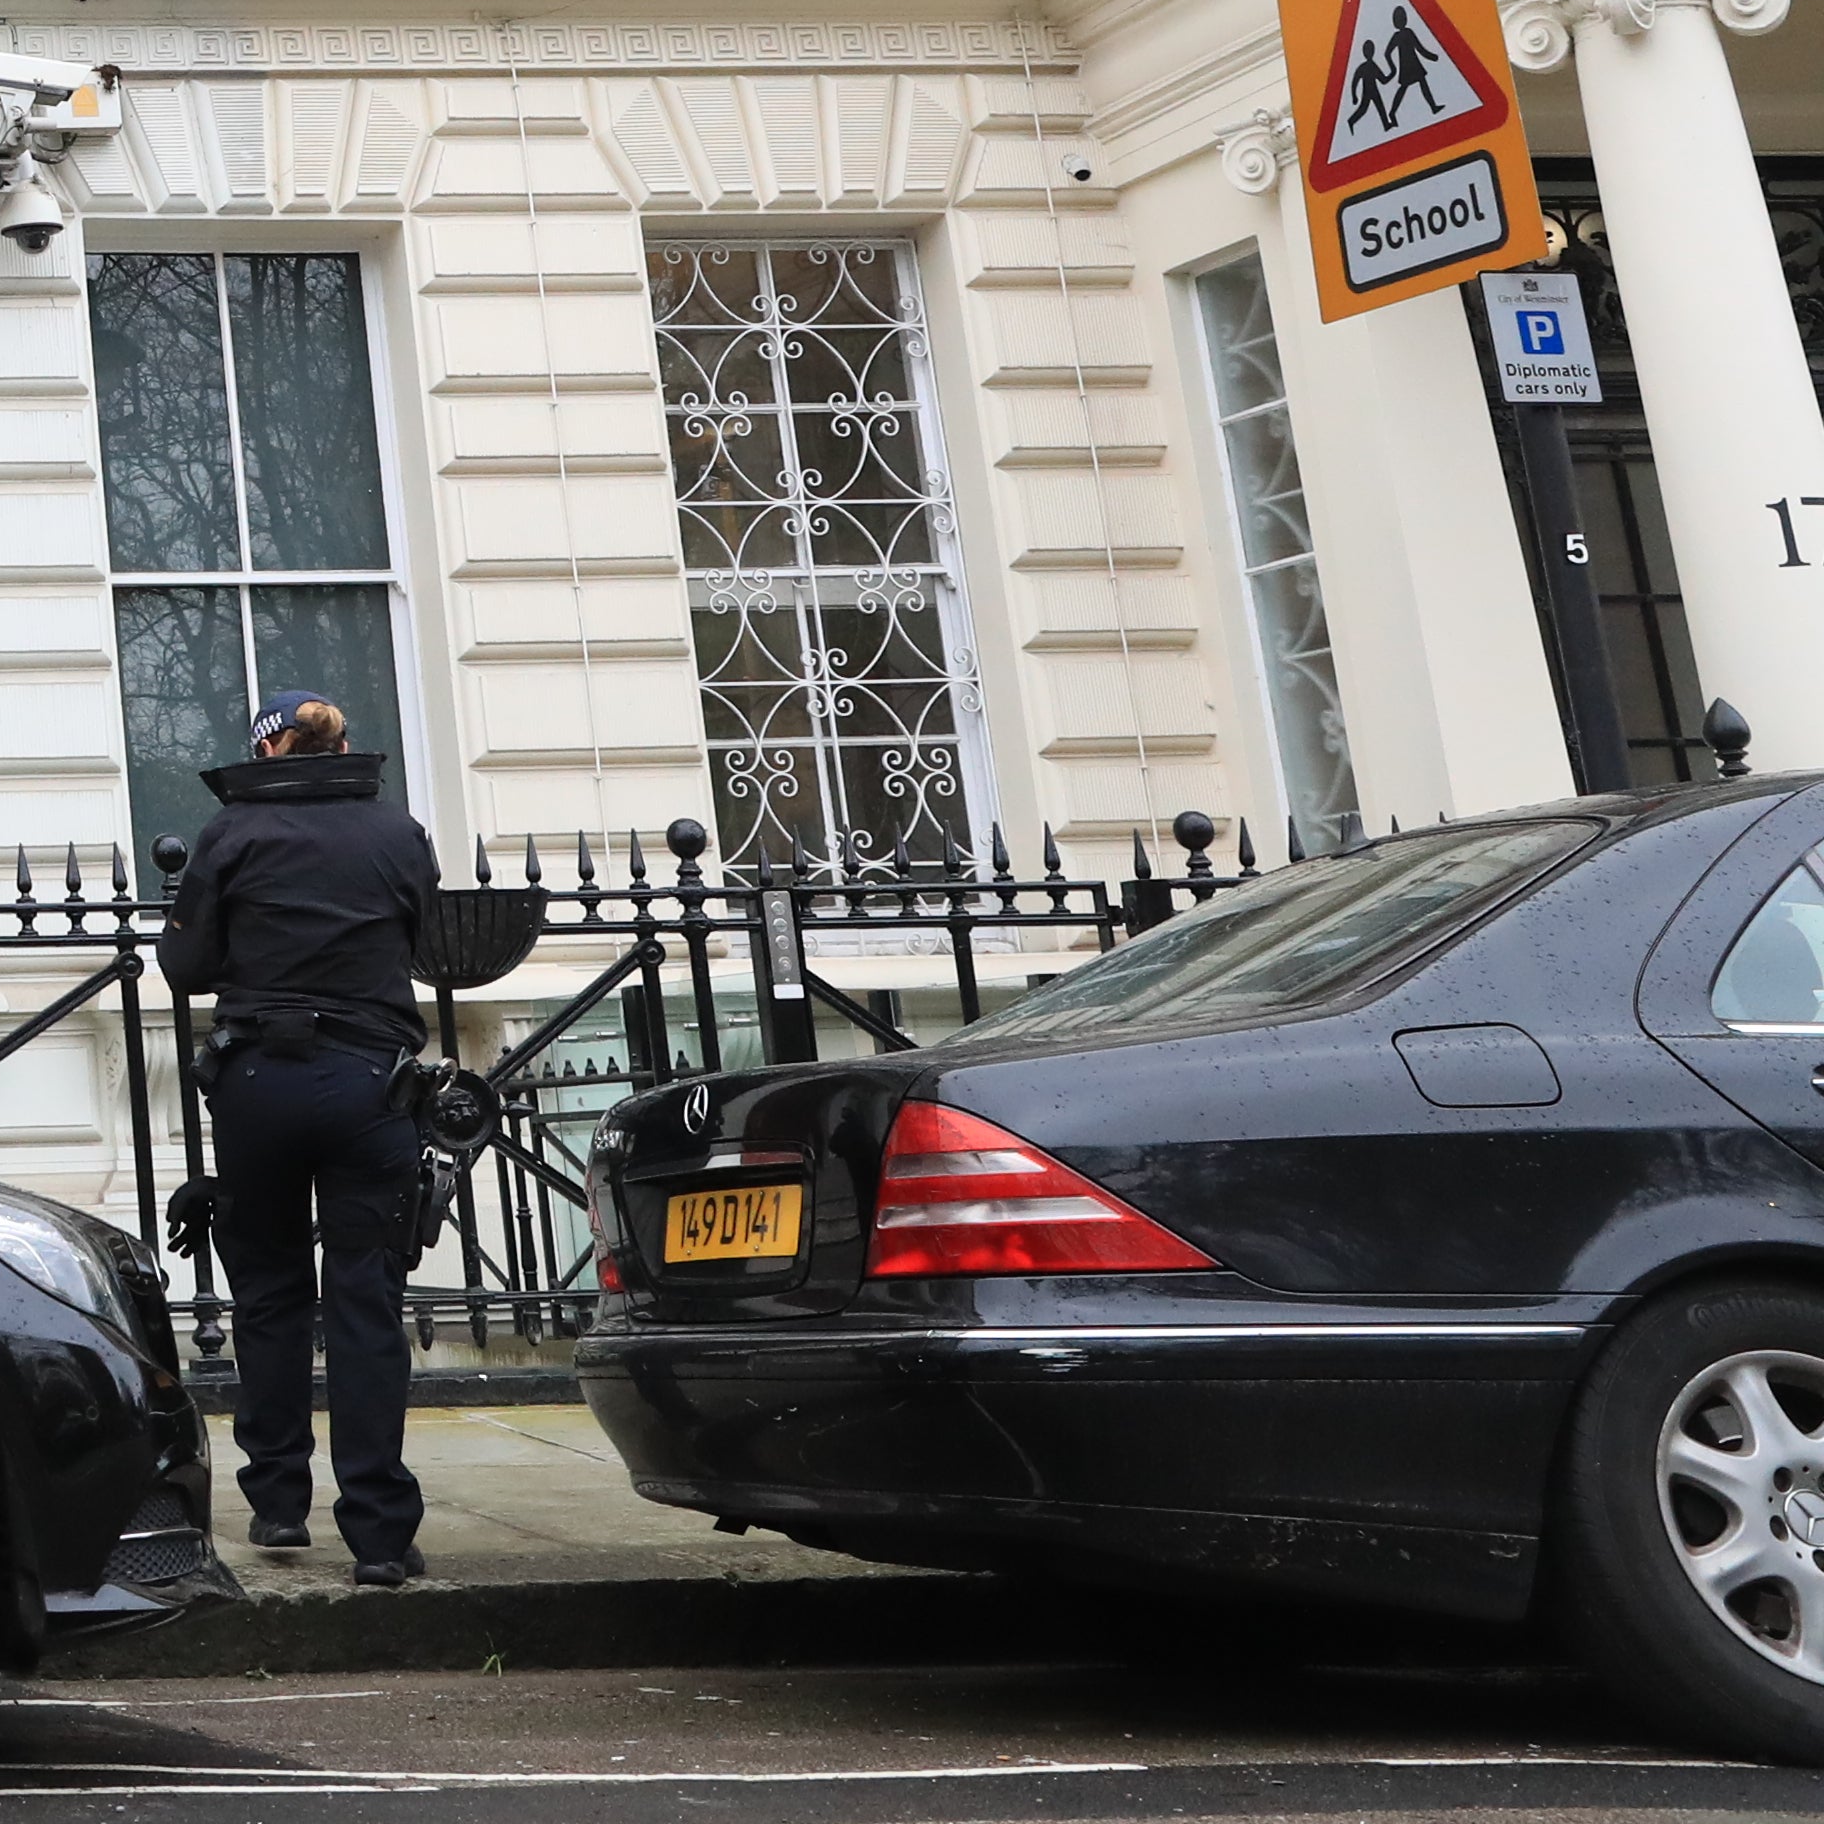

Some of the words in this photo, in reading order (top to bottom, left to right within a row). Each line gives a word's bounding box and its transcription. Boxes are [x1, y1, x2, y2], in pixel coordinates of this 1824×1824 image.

[1360, 183, 1485, 257] School
[1527, 315, 1555, 350] P
[1505, 363, 1591, 379] Diplomatic
[1515, 384, 1549, 395] cars
[1554, 381, 1587, 397] only
[1566, 533, 1590, 565] 5
[680, 1190, 782, 1248] 149D141
